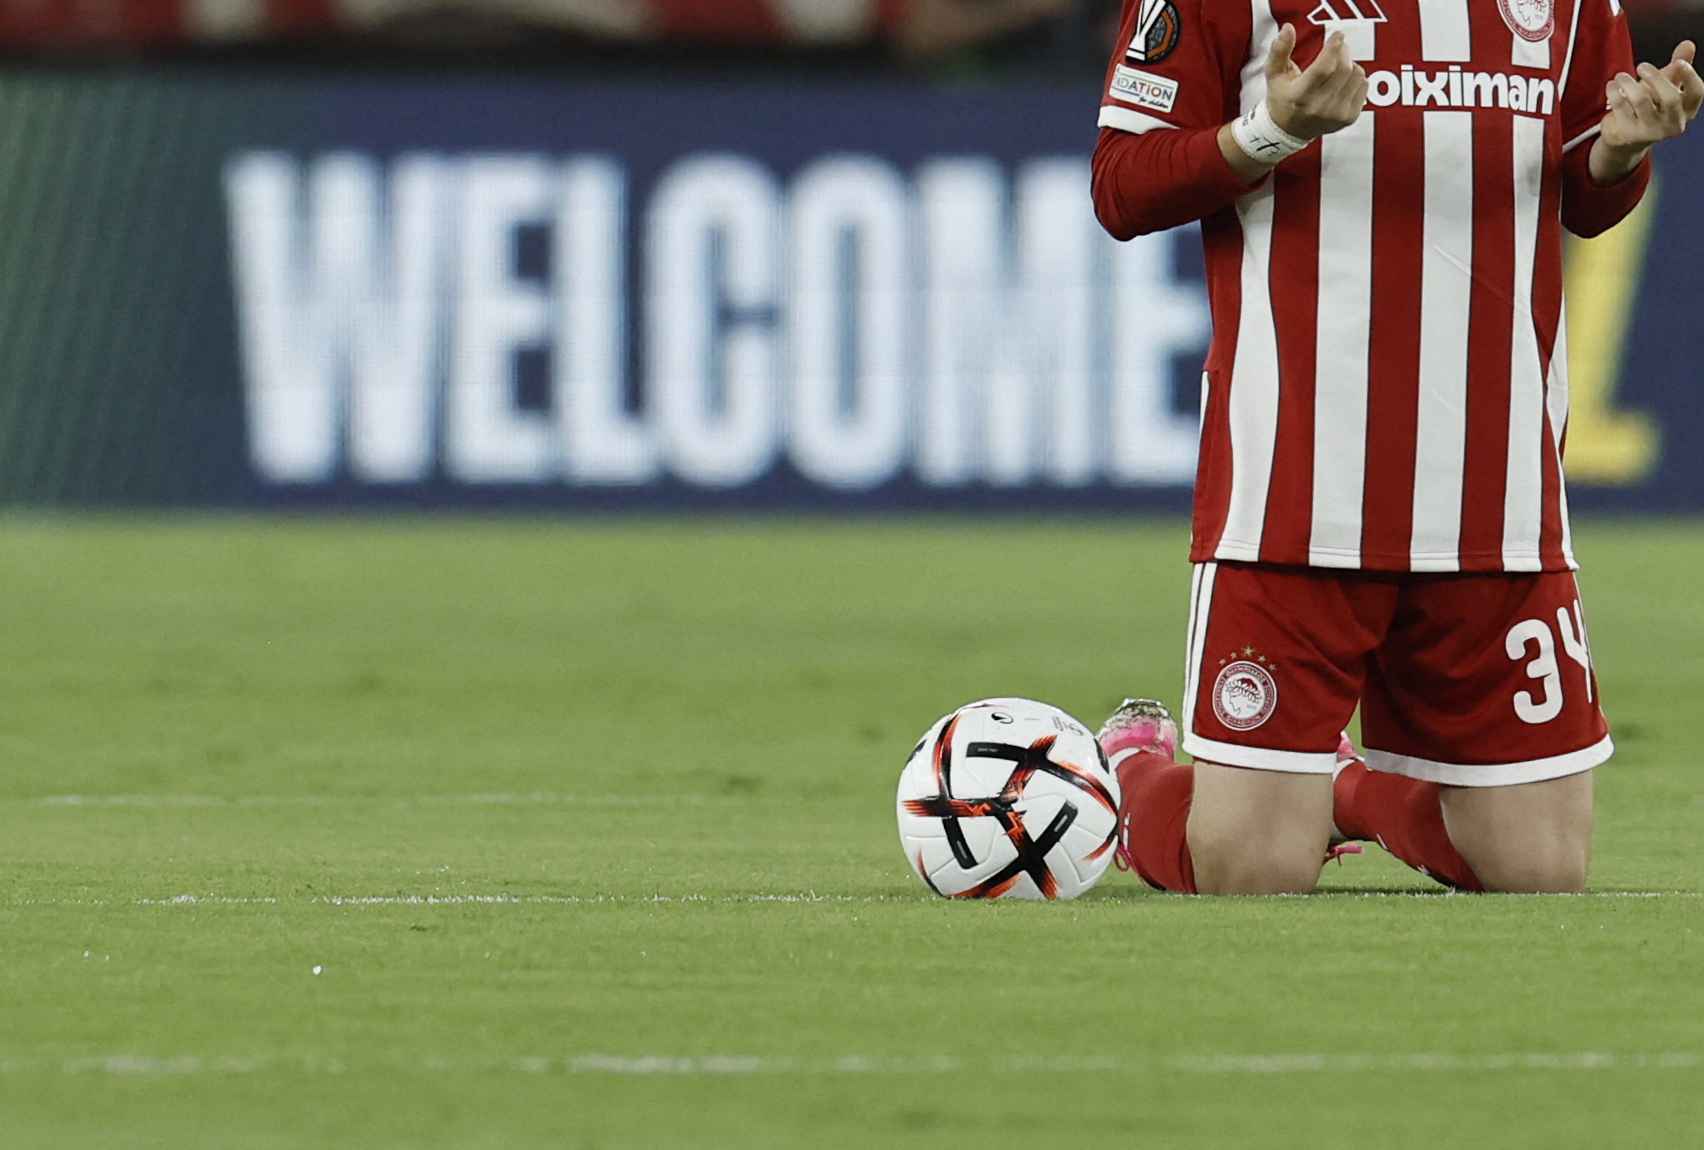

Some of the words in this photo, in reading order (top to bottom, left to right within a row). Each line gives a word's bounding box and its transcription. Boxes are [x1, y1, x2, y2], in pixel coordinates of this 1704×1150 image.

[1363, 63, 1555, 115] oiximan
[224, 150, 1204, 487] WELCOME
[1505, 599, 1593, 724] 34
